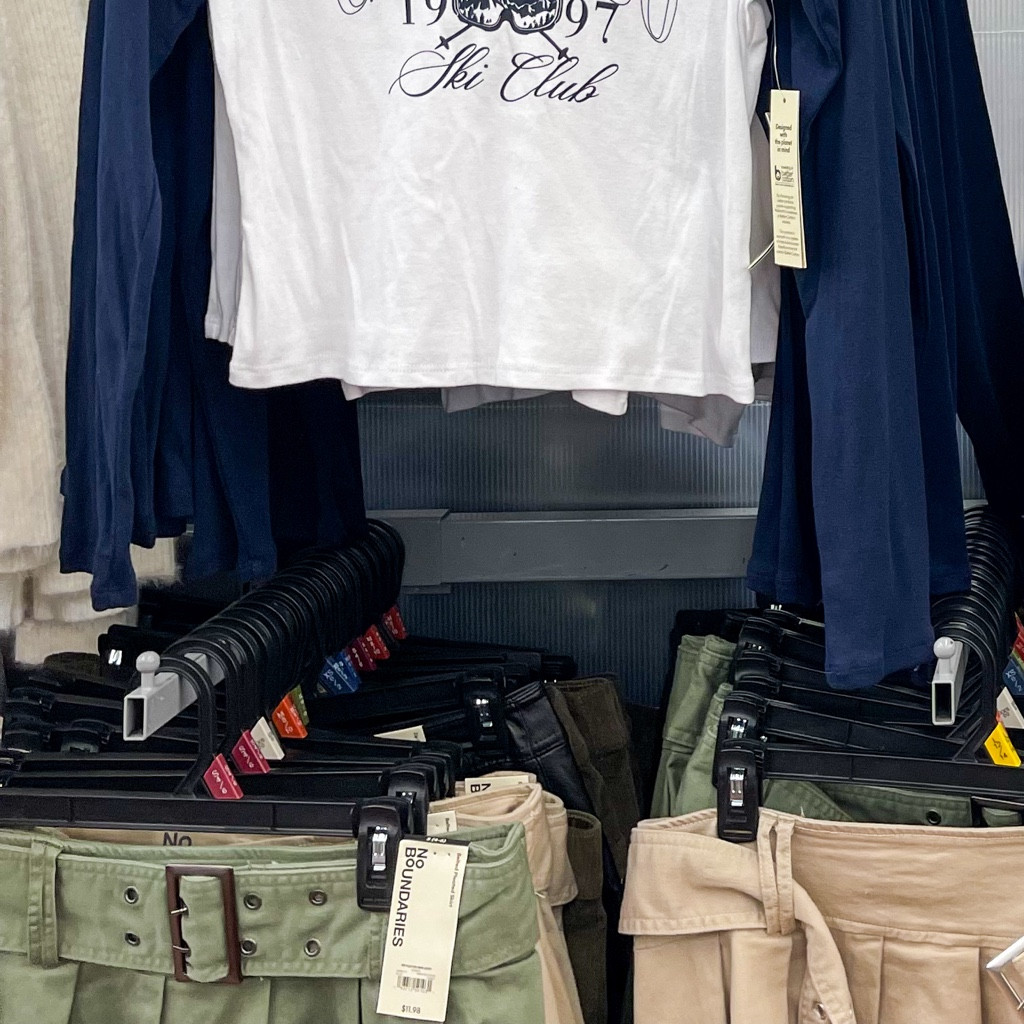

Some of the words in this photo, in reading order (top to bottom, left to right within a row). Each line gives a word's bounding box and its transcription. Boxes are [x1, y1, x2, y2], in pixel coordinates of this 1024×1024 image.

[388, 42, 491, 98] Ski
[499, 52, 620, 103] Club
[415, 847, 428, 869] NO
[392, 847, 417, 947] BOUNDARIES
[401, 1004, 421, 1015] $11.98
